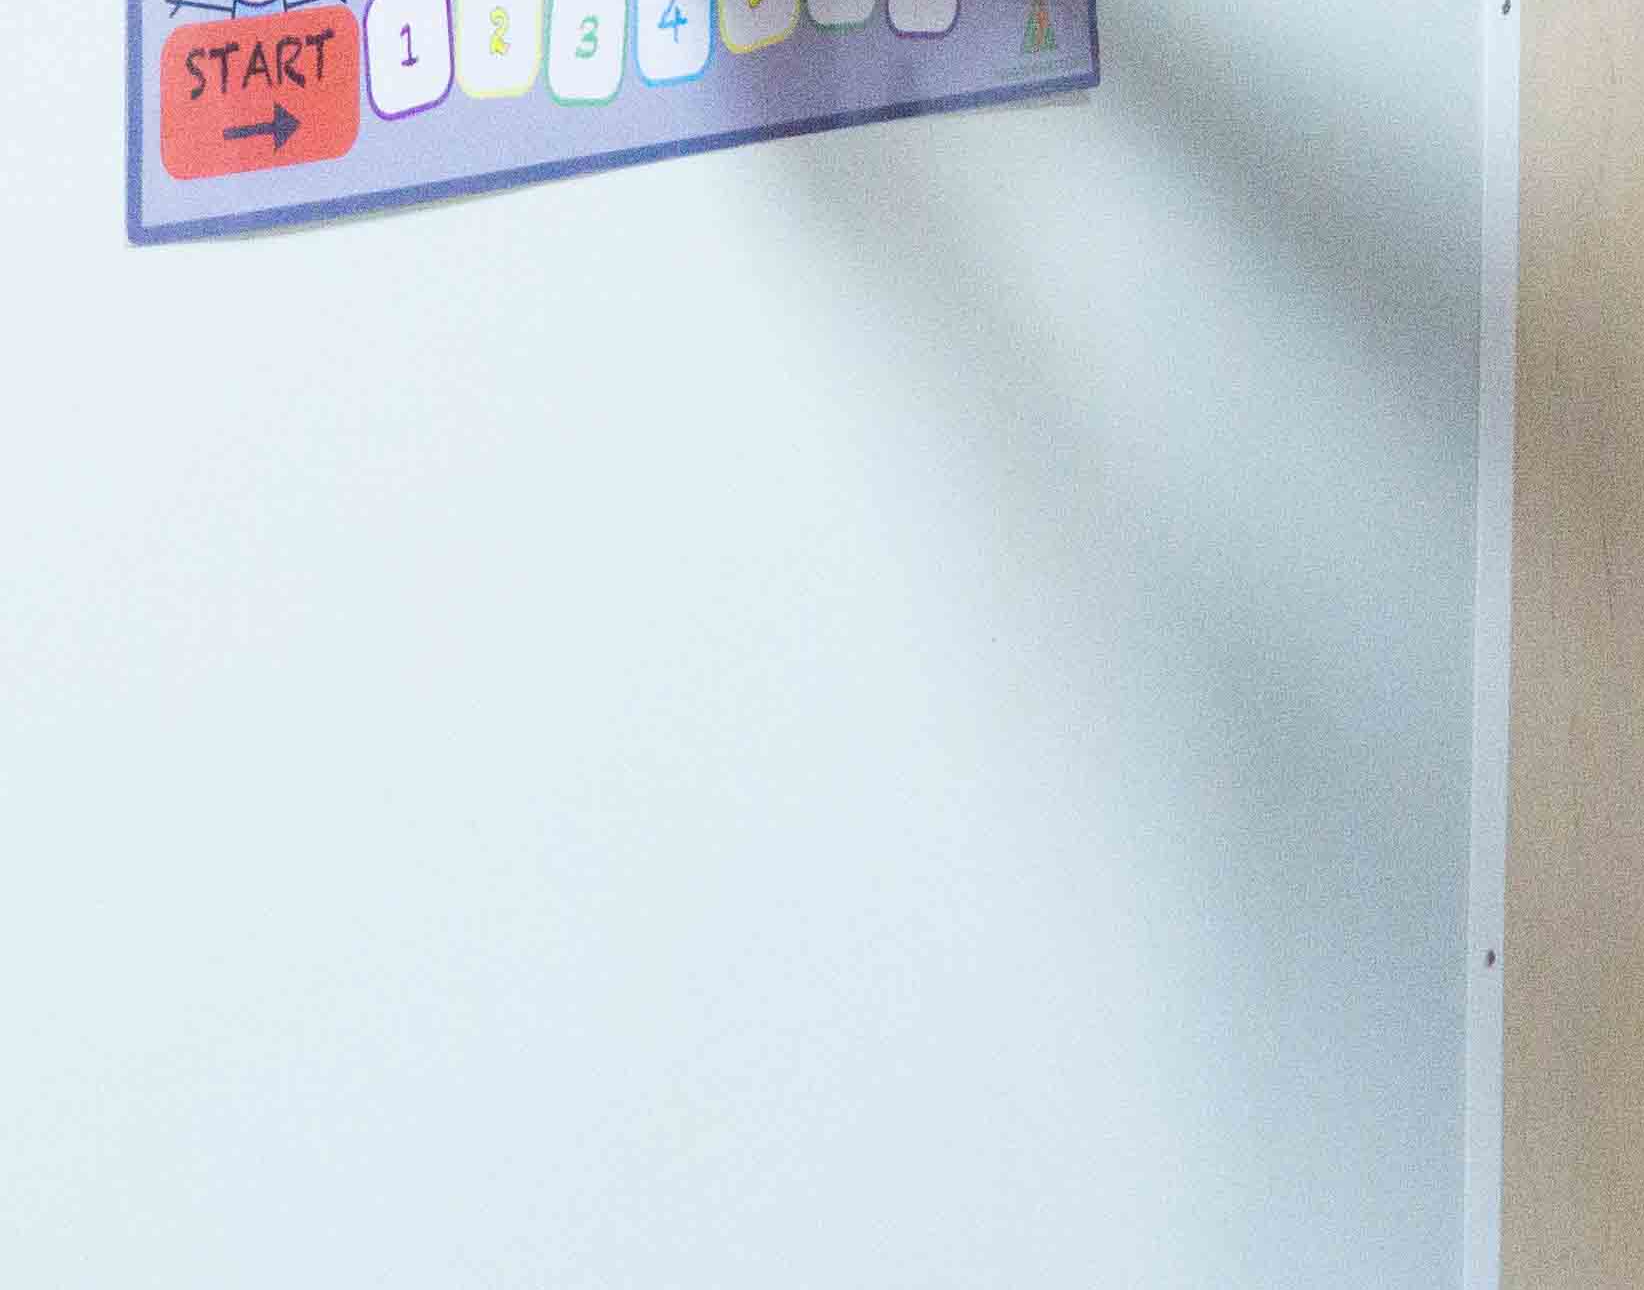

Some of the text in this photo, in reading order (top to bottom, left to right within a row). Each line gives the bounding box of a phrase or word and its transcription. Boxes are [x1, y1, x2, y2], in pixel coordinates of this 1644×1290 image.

[399, 23, 419, 68] 1
[489, 5, 511, 57] 2
[575, 15, 600, 60] 3
[184, 28, 336, 100] START
